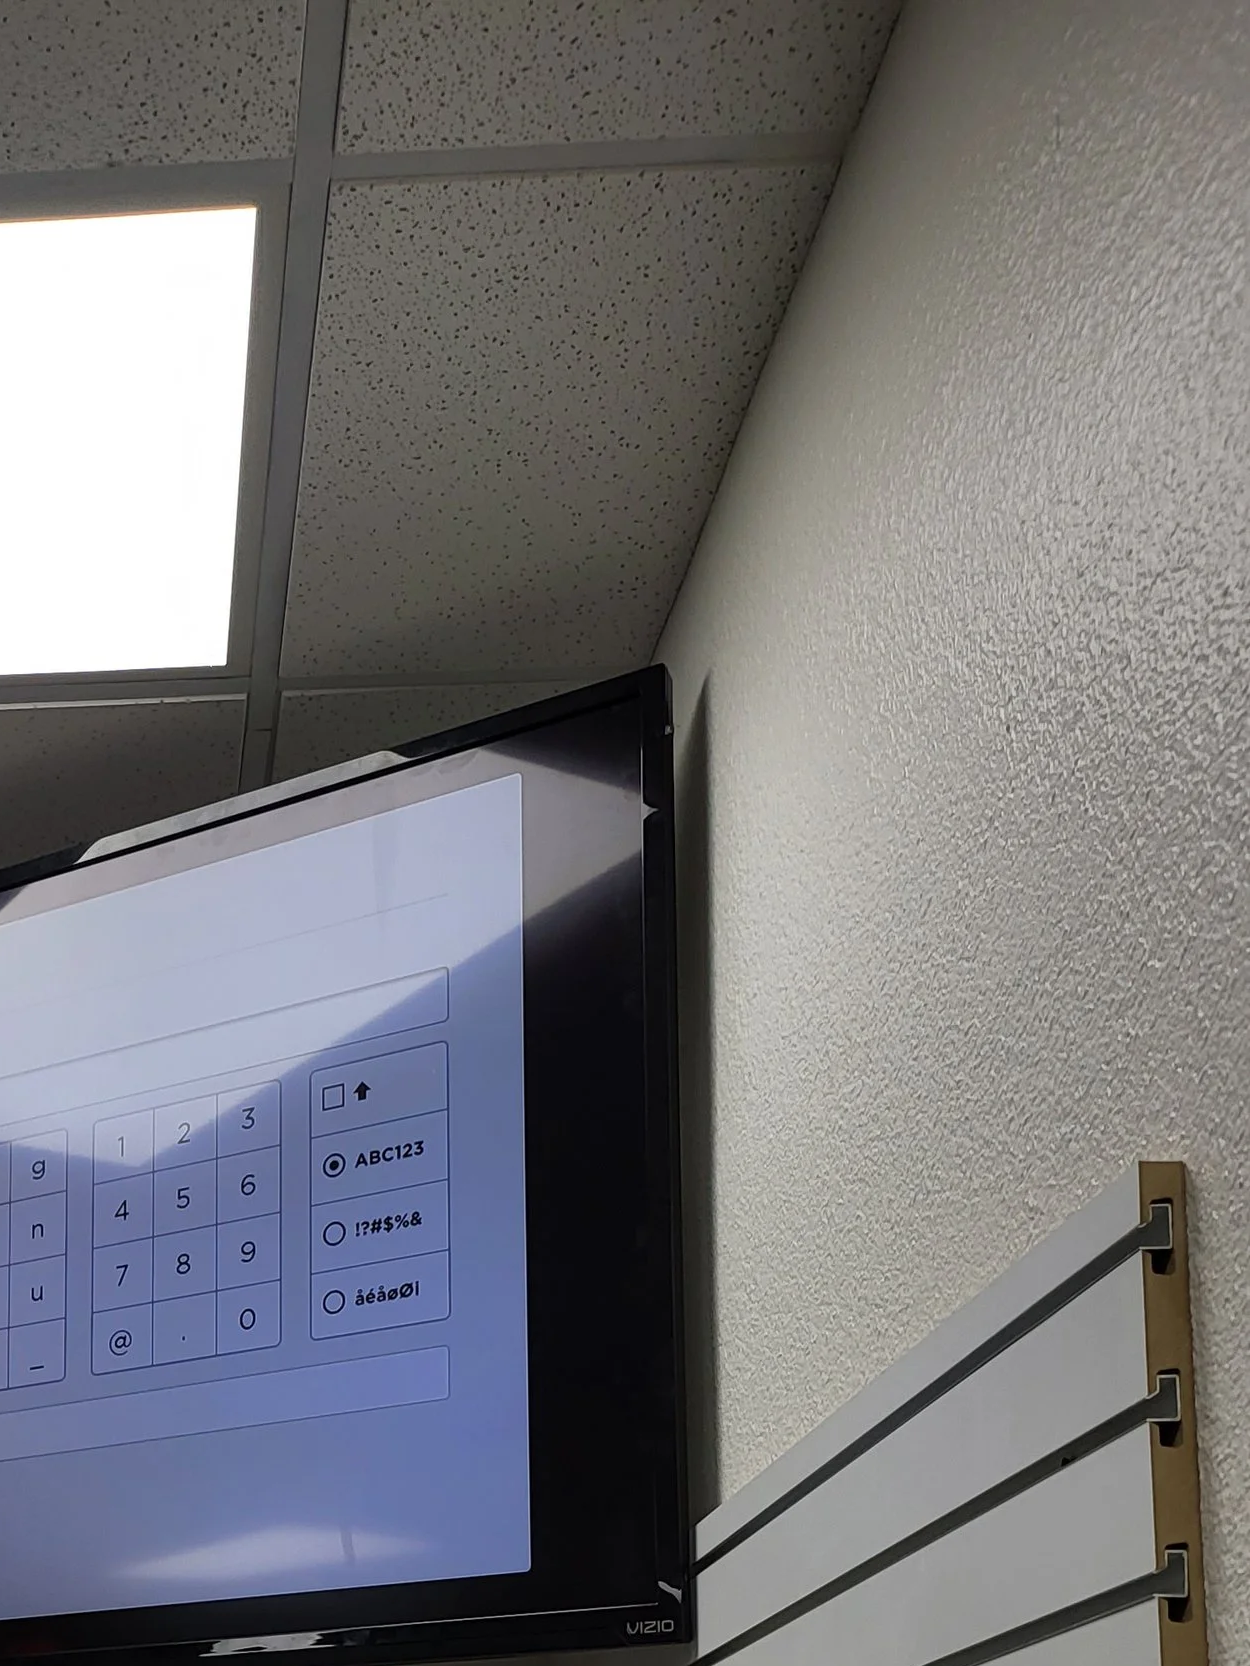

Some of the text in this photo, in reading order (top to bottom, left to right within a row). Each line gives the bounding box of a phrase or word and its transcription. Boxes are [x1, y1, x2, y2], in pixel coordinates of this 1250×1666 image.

[177, 1122, 191, 1145] 2
[241, 1106, 255, 1130] 3
[355, 1140, 425, 1169] ABC123
[31, 1159, 46, 1181] g
[114, 1174, 256, 1221] 4 5 6
[31, 1223, 44, 1240] n
[355, 1211, 422, 1237] !?#$%&
[115, 1241, 256, 1287] 7 8 9
[31, 1285, 44, 1302] u
[108, 1329, 133, 1356] @
[626, 1620, 674, 1635] VIZIO
